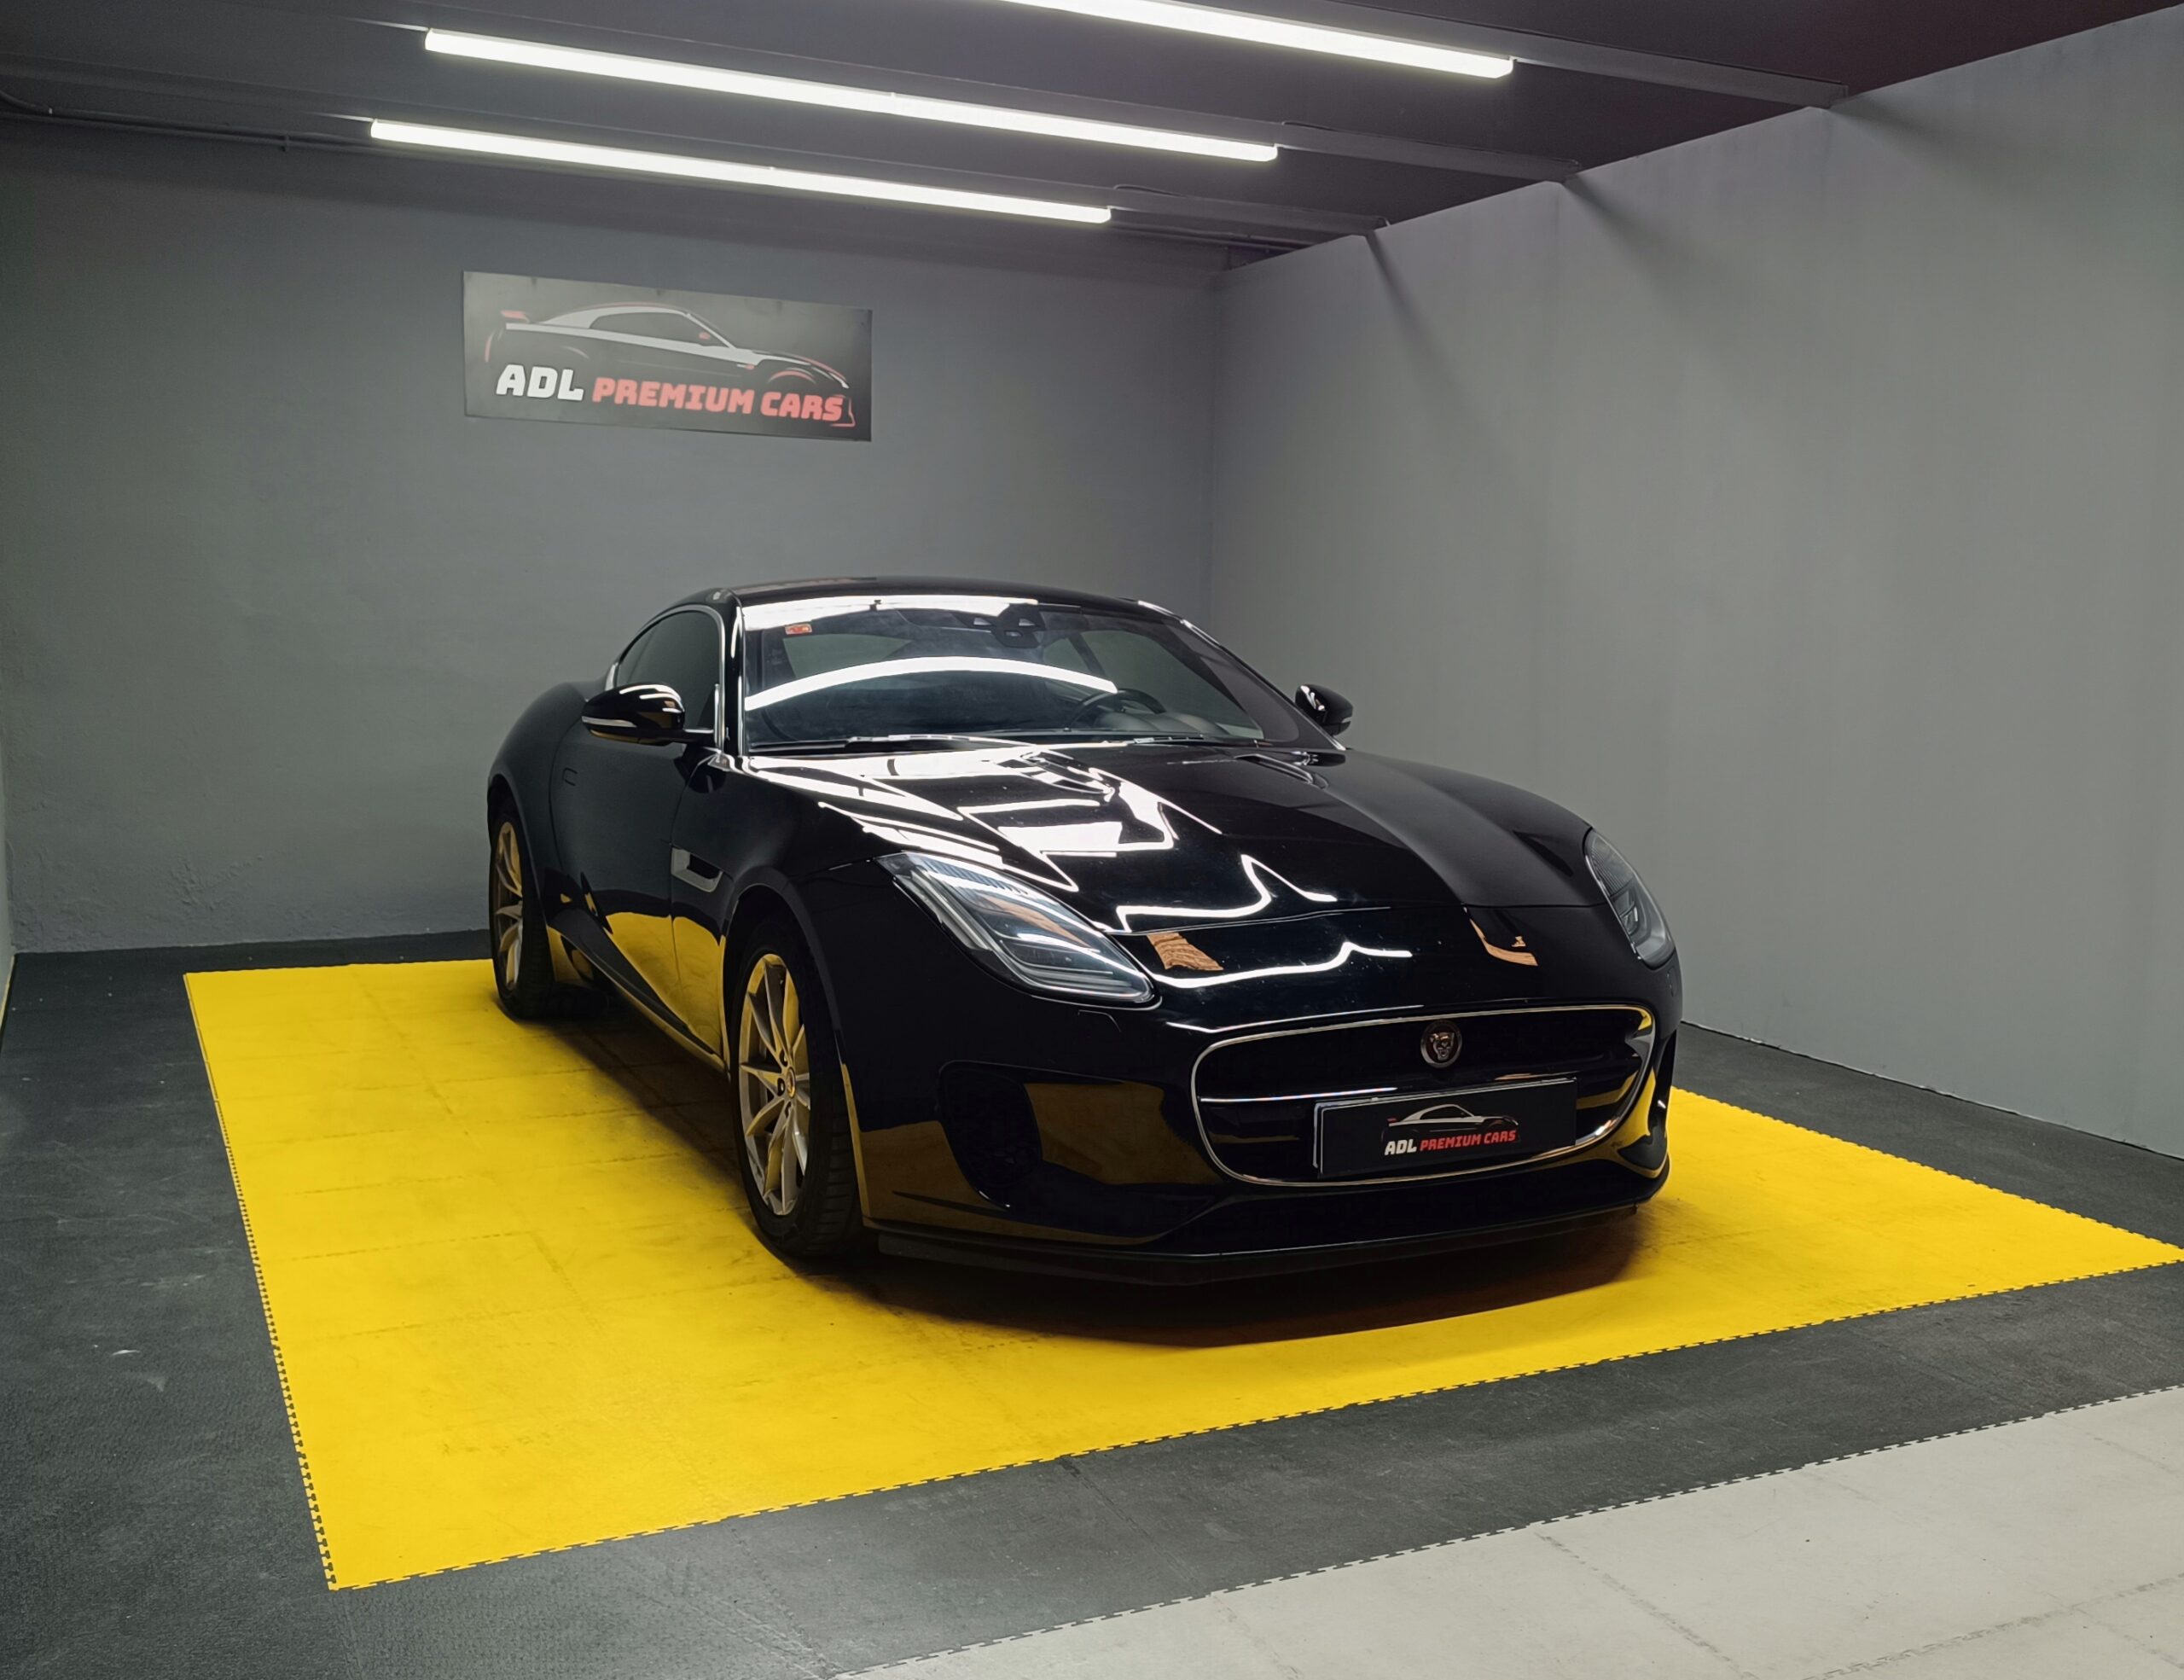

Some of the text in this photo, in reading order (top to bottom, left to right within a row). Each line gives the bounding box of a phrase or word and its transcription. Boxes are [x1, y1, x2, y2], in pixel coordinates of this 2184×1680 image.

[496, 364, 844, 422] ADL PREMIUM CARS
[1384, 1130, 1517, 1156] ADL PREMIUM CARS
